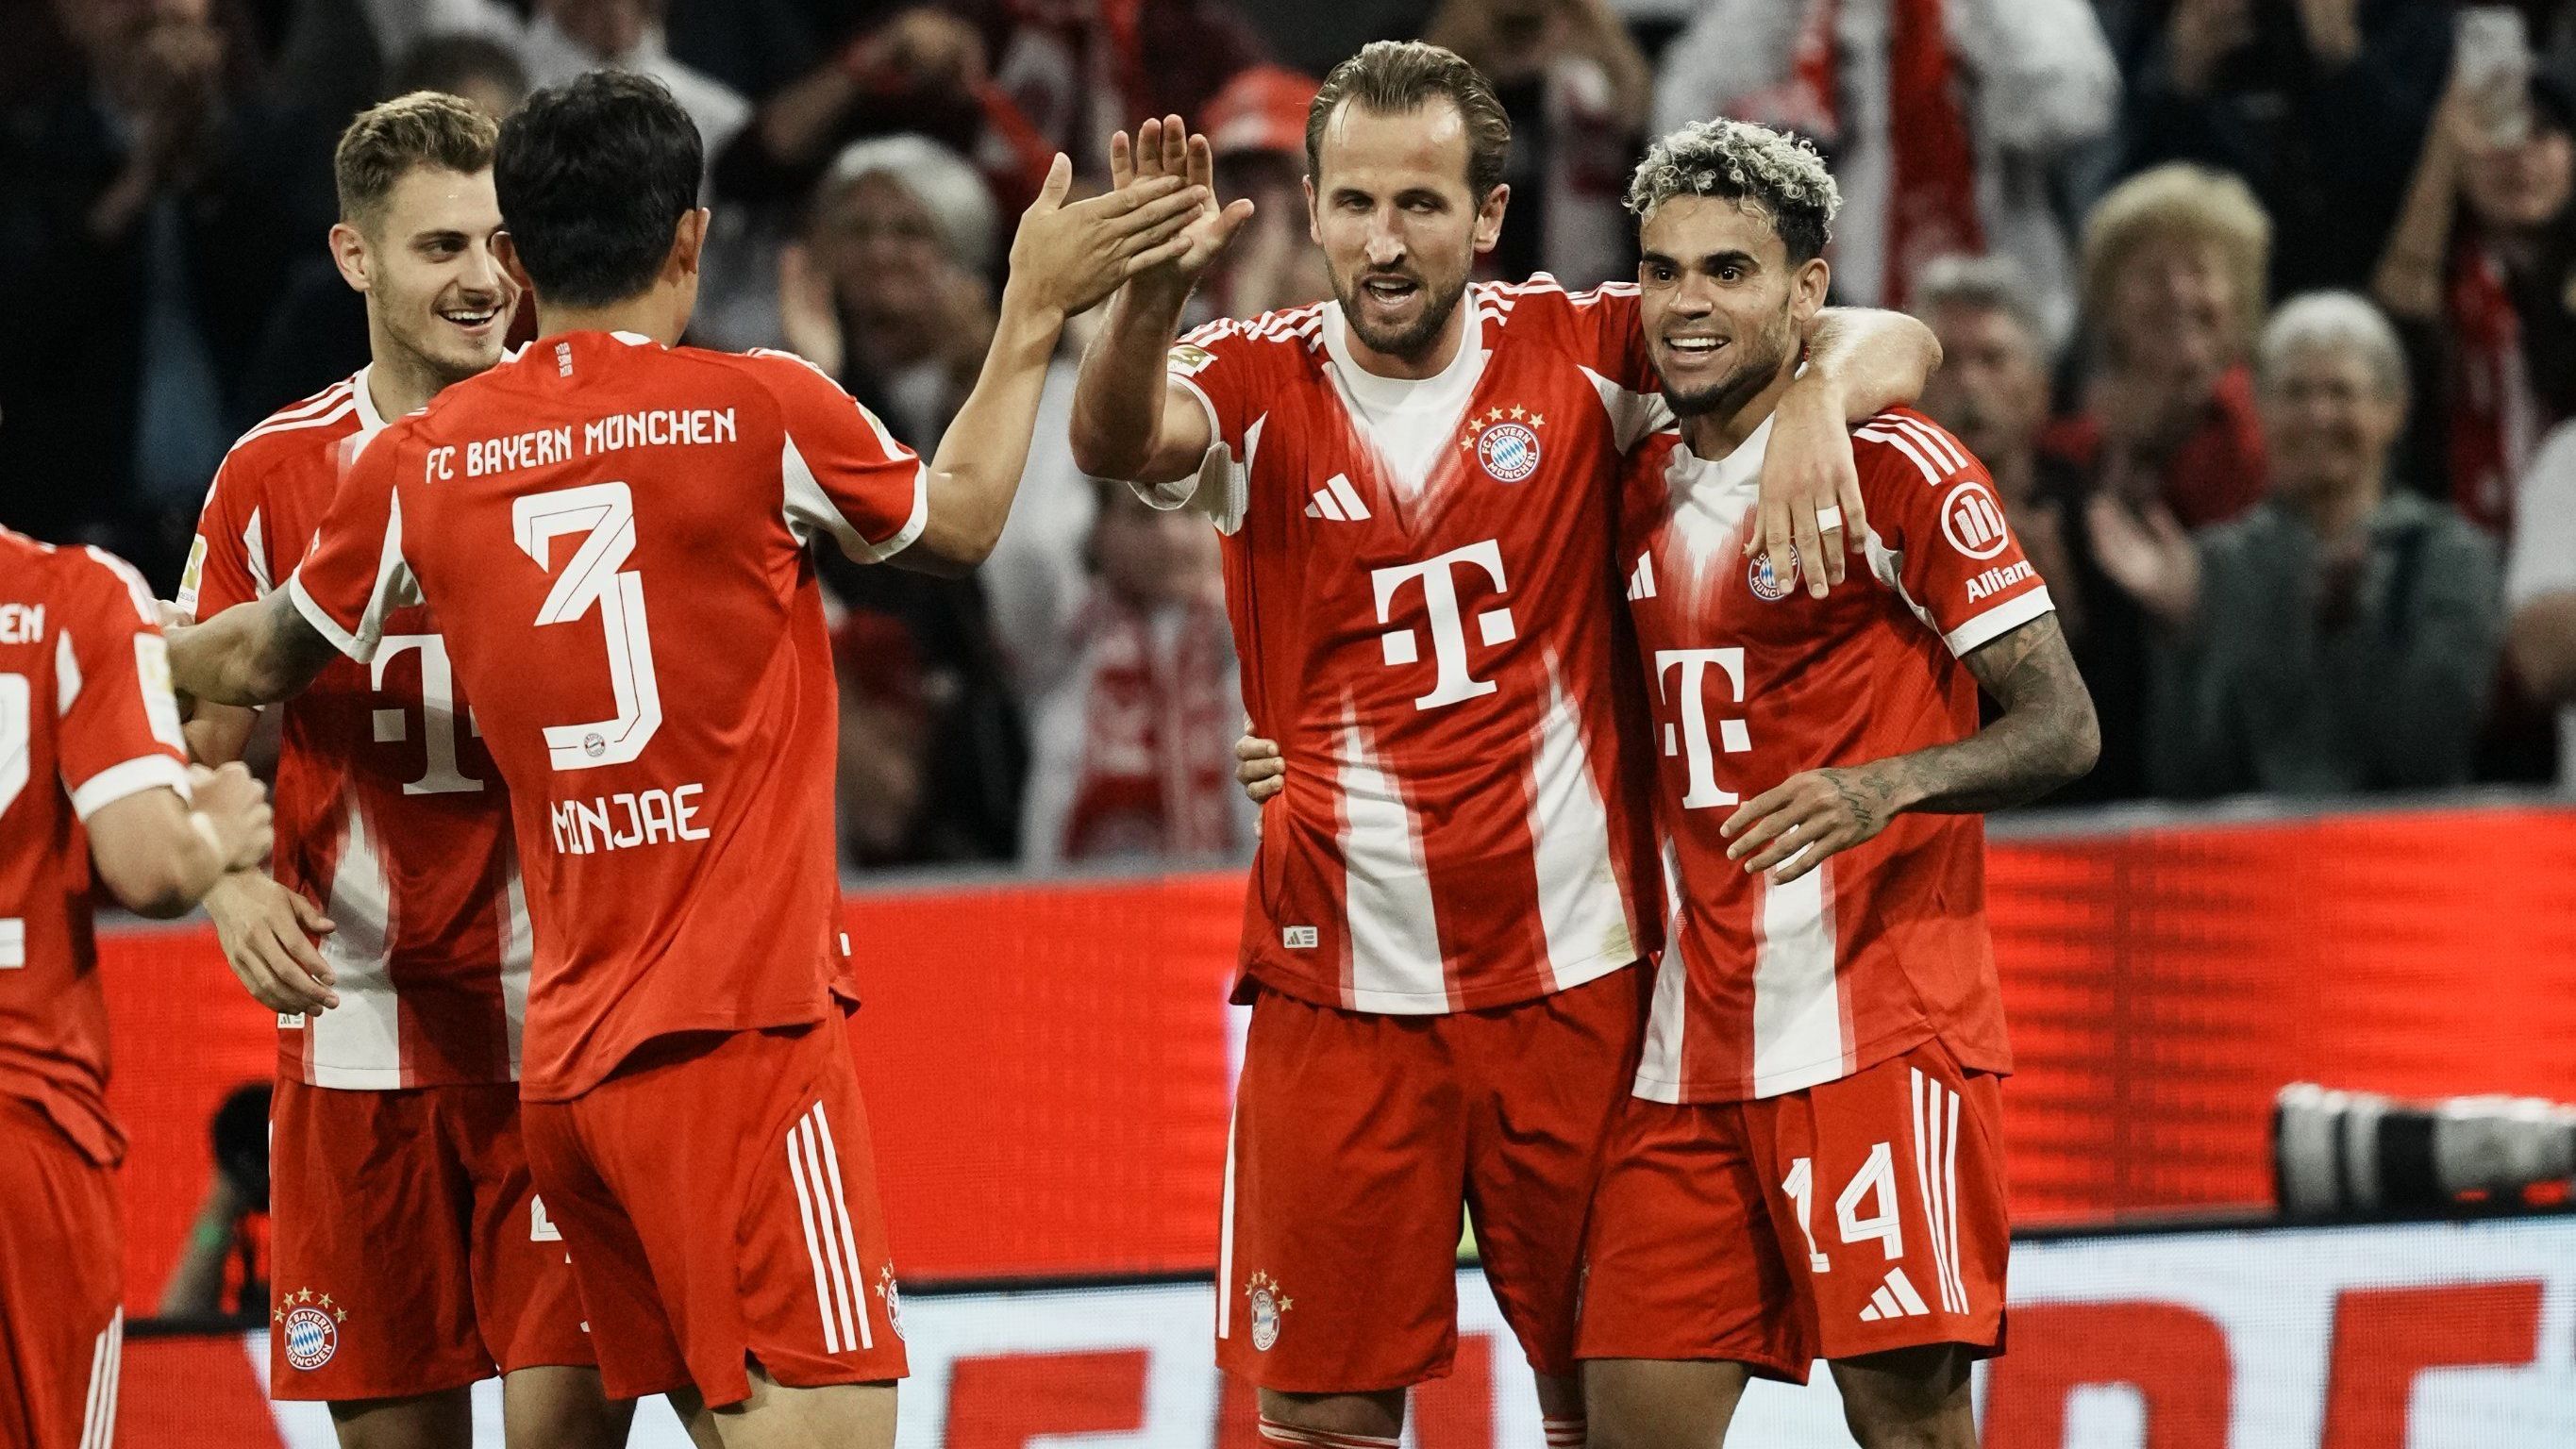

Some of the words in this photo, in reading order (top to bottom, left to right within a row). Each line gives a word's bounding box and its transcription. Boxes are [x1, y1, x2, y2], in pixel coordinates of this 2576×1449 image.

[426, 445, 456, 484] FC
[466, 425, 572, 477] BAYERN
[585, 408, 737, 456] MÜNCHEN
[1482, 440, 1492, 454] FC
[1488, 427, 1531, 444] BAYERN
[1965, 559, 2035, 605] Allian
[512, 481, 662, 771] 3
[1371, 538, 1513, 711] T
[1655, 647, 1748, 809] T
[550, 782, 711, 855] MINJAE
[1781, 1141, 1903, 1273] 14
[293, 1312, 332, 1335] BAYERN
